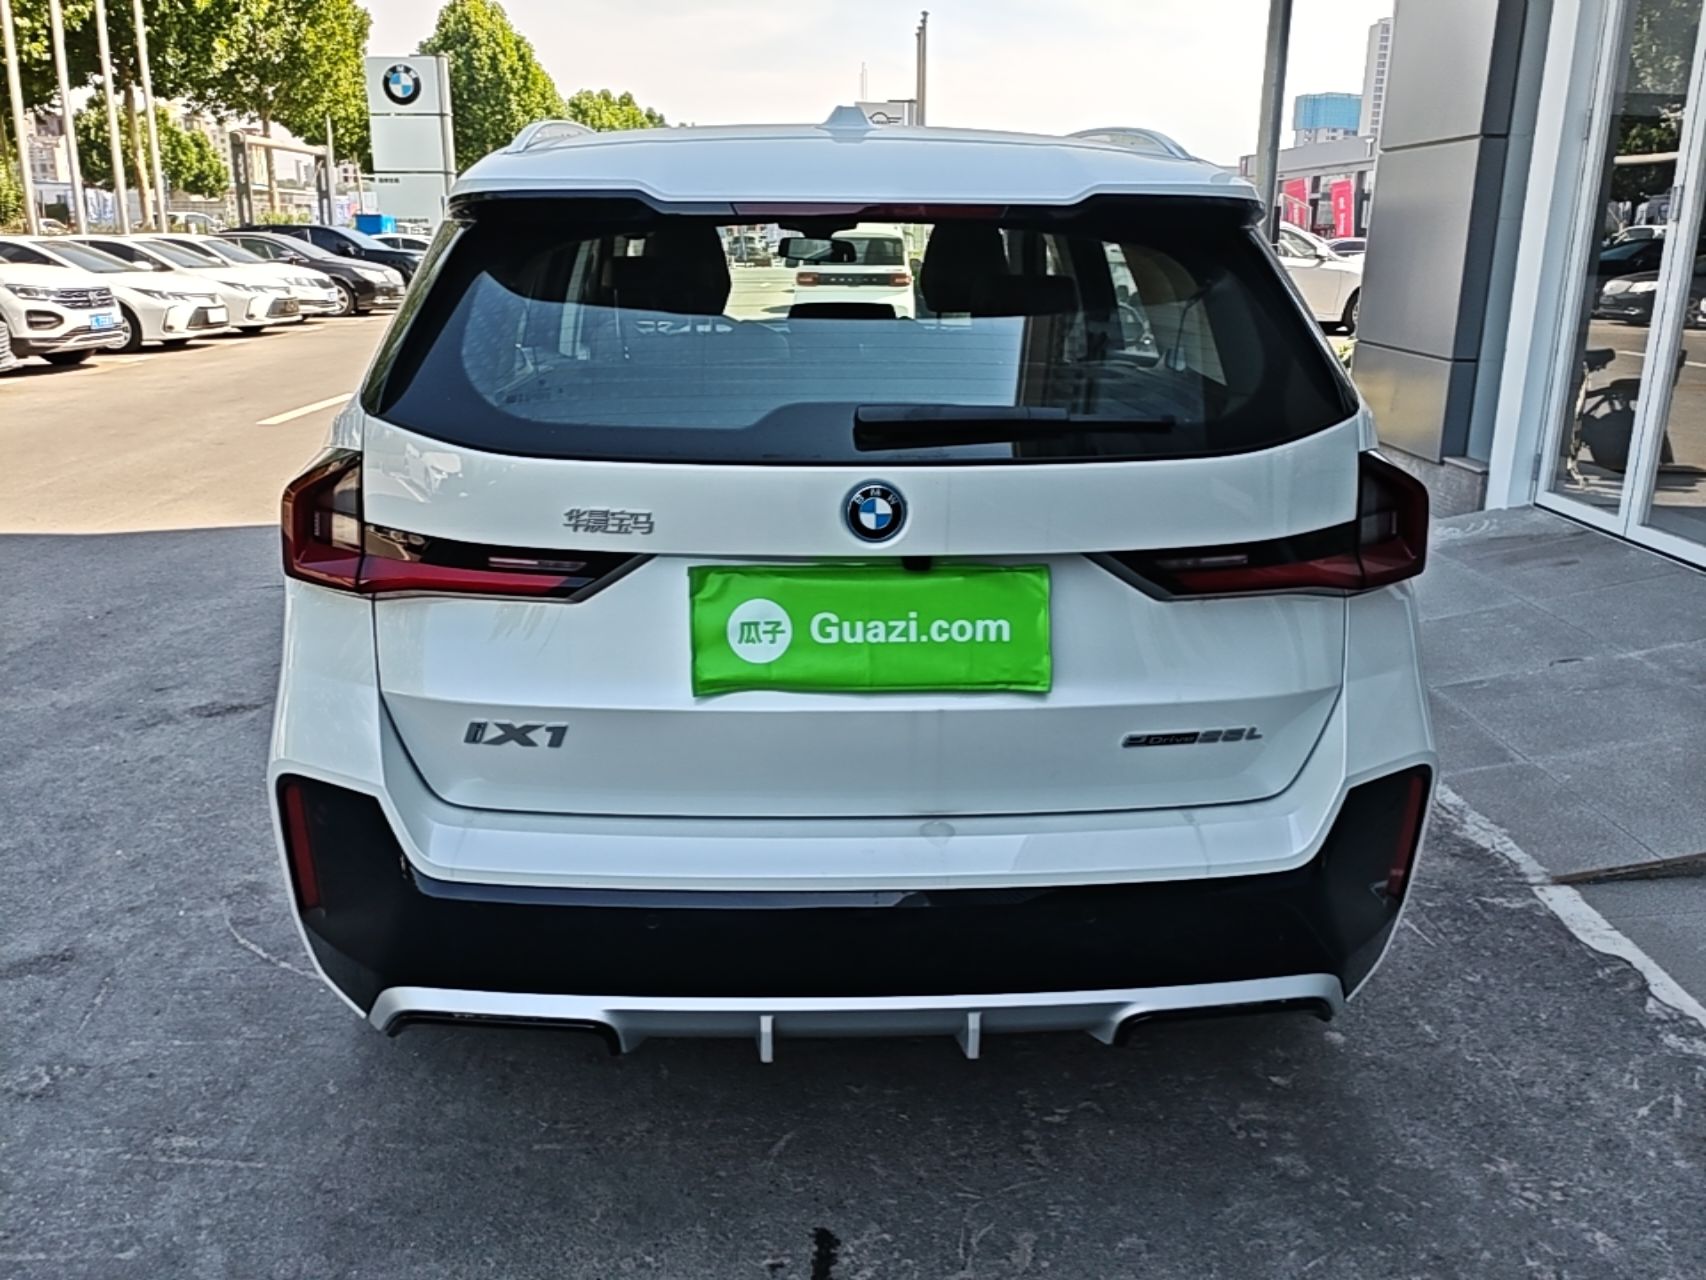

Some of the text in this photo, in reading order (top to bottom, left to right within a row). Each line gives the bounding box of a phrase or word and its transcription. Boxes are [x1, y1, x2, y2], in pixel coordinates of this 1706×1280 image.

[562, 508, 656, 535] 华晨宝马
[737, 620, 786, 645] 瓜子
[810, 611, 1011, 644] Guazi.com
